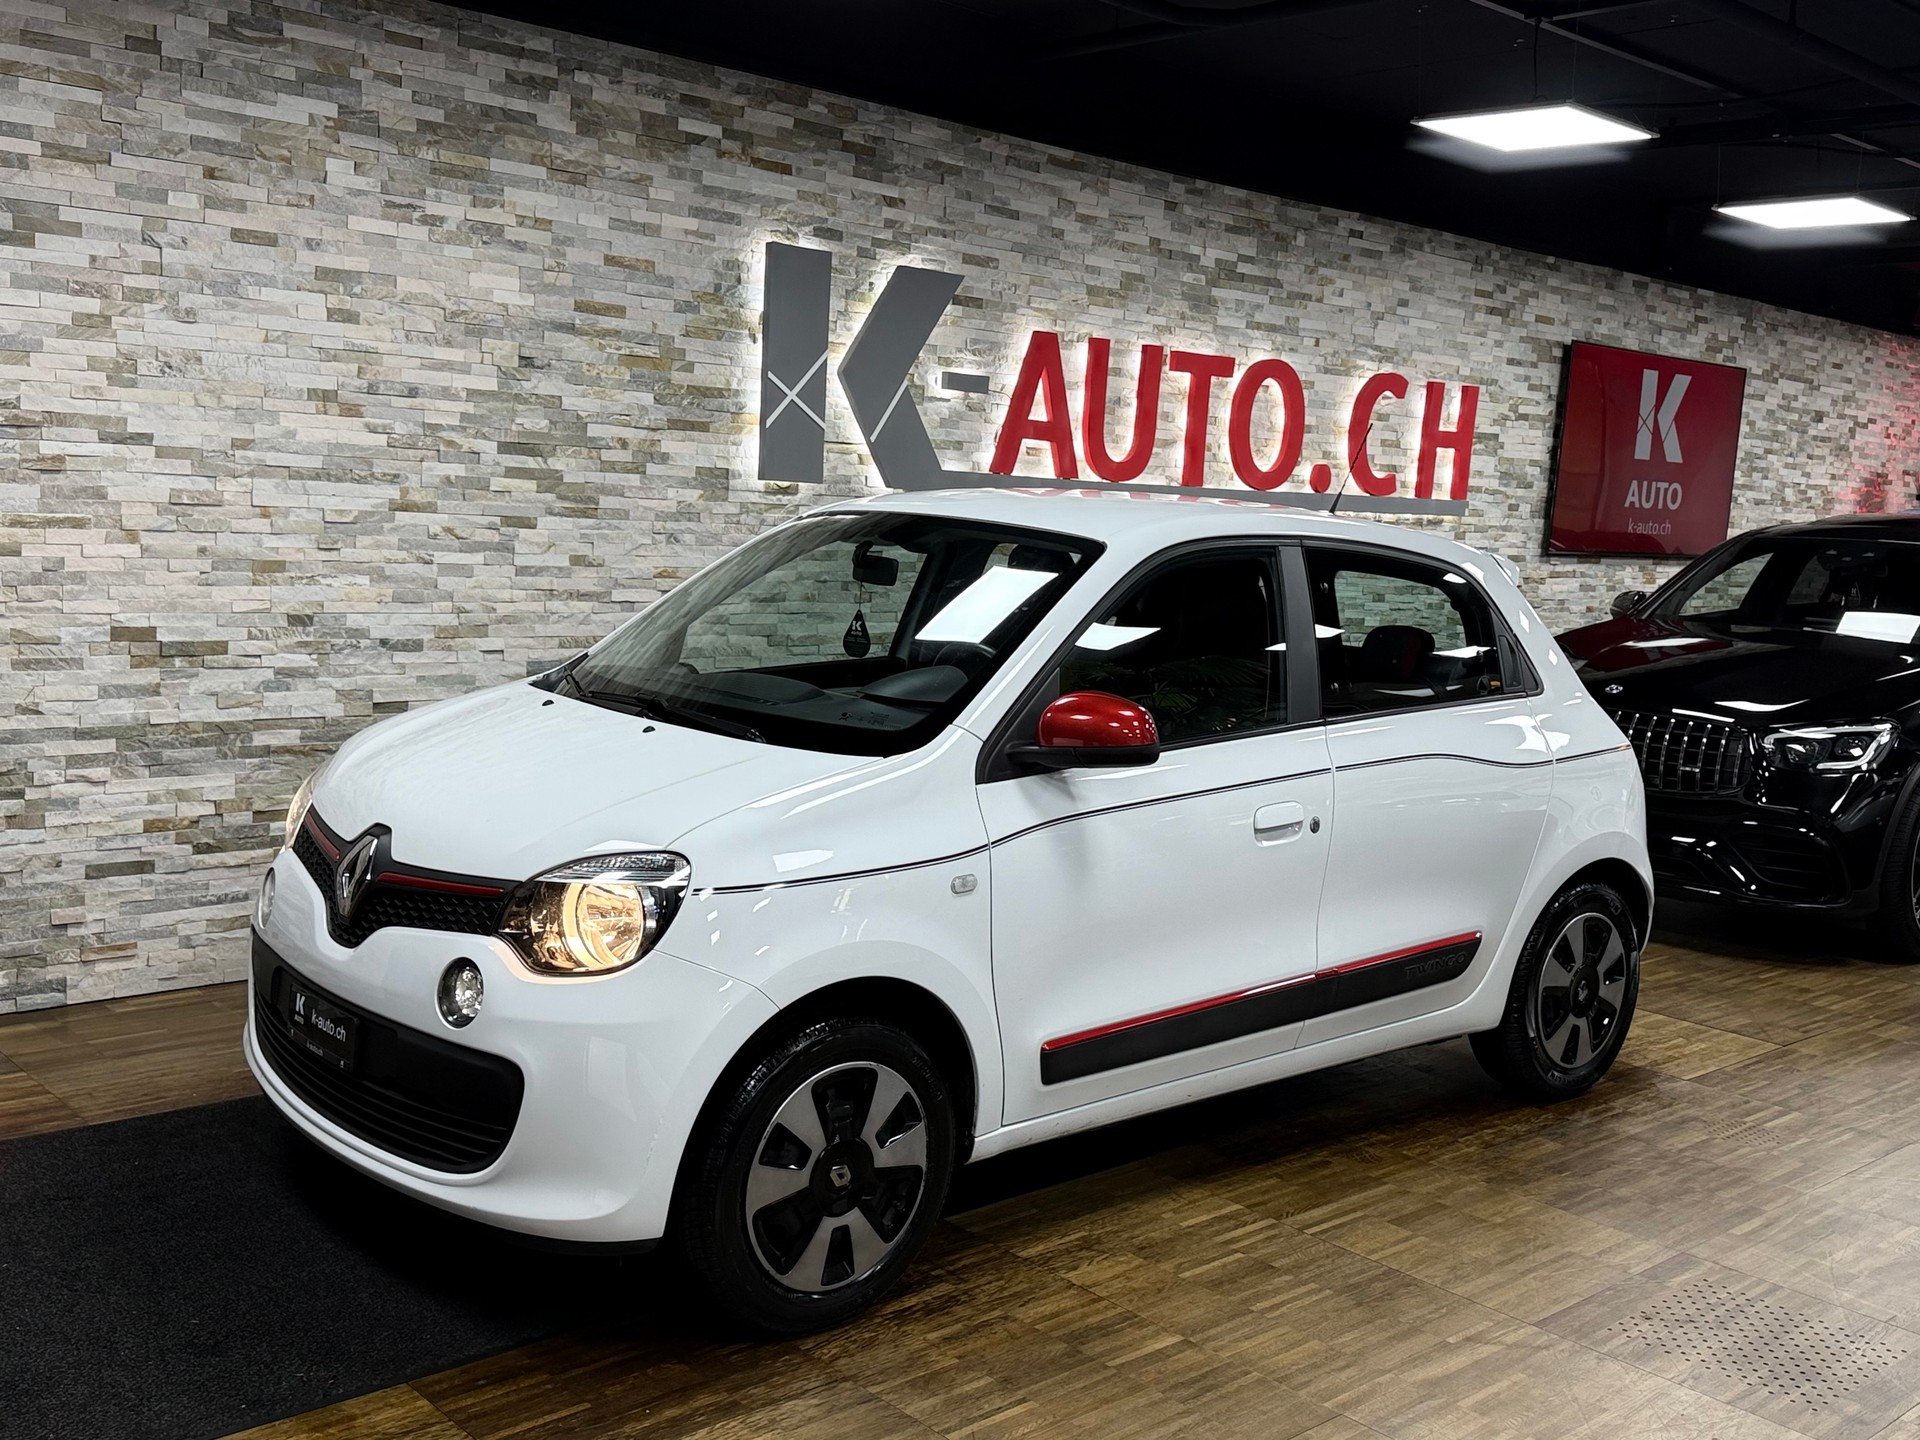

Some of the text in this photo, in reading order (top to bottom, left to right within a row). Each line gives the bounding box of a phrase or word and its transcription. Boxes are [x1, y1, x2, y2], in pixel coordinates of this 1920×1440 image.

[1634, 368, 1692, 463] K
[1624, 480, 1682, 510] AUTO
[1628, 518, 1671, 535] k-auto.ch
[1404, 952, 1467, 977] TWINGO
[296, 993, 305, 1014] K
[311, 1008, 346, 1042] k-auto.ch
